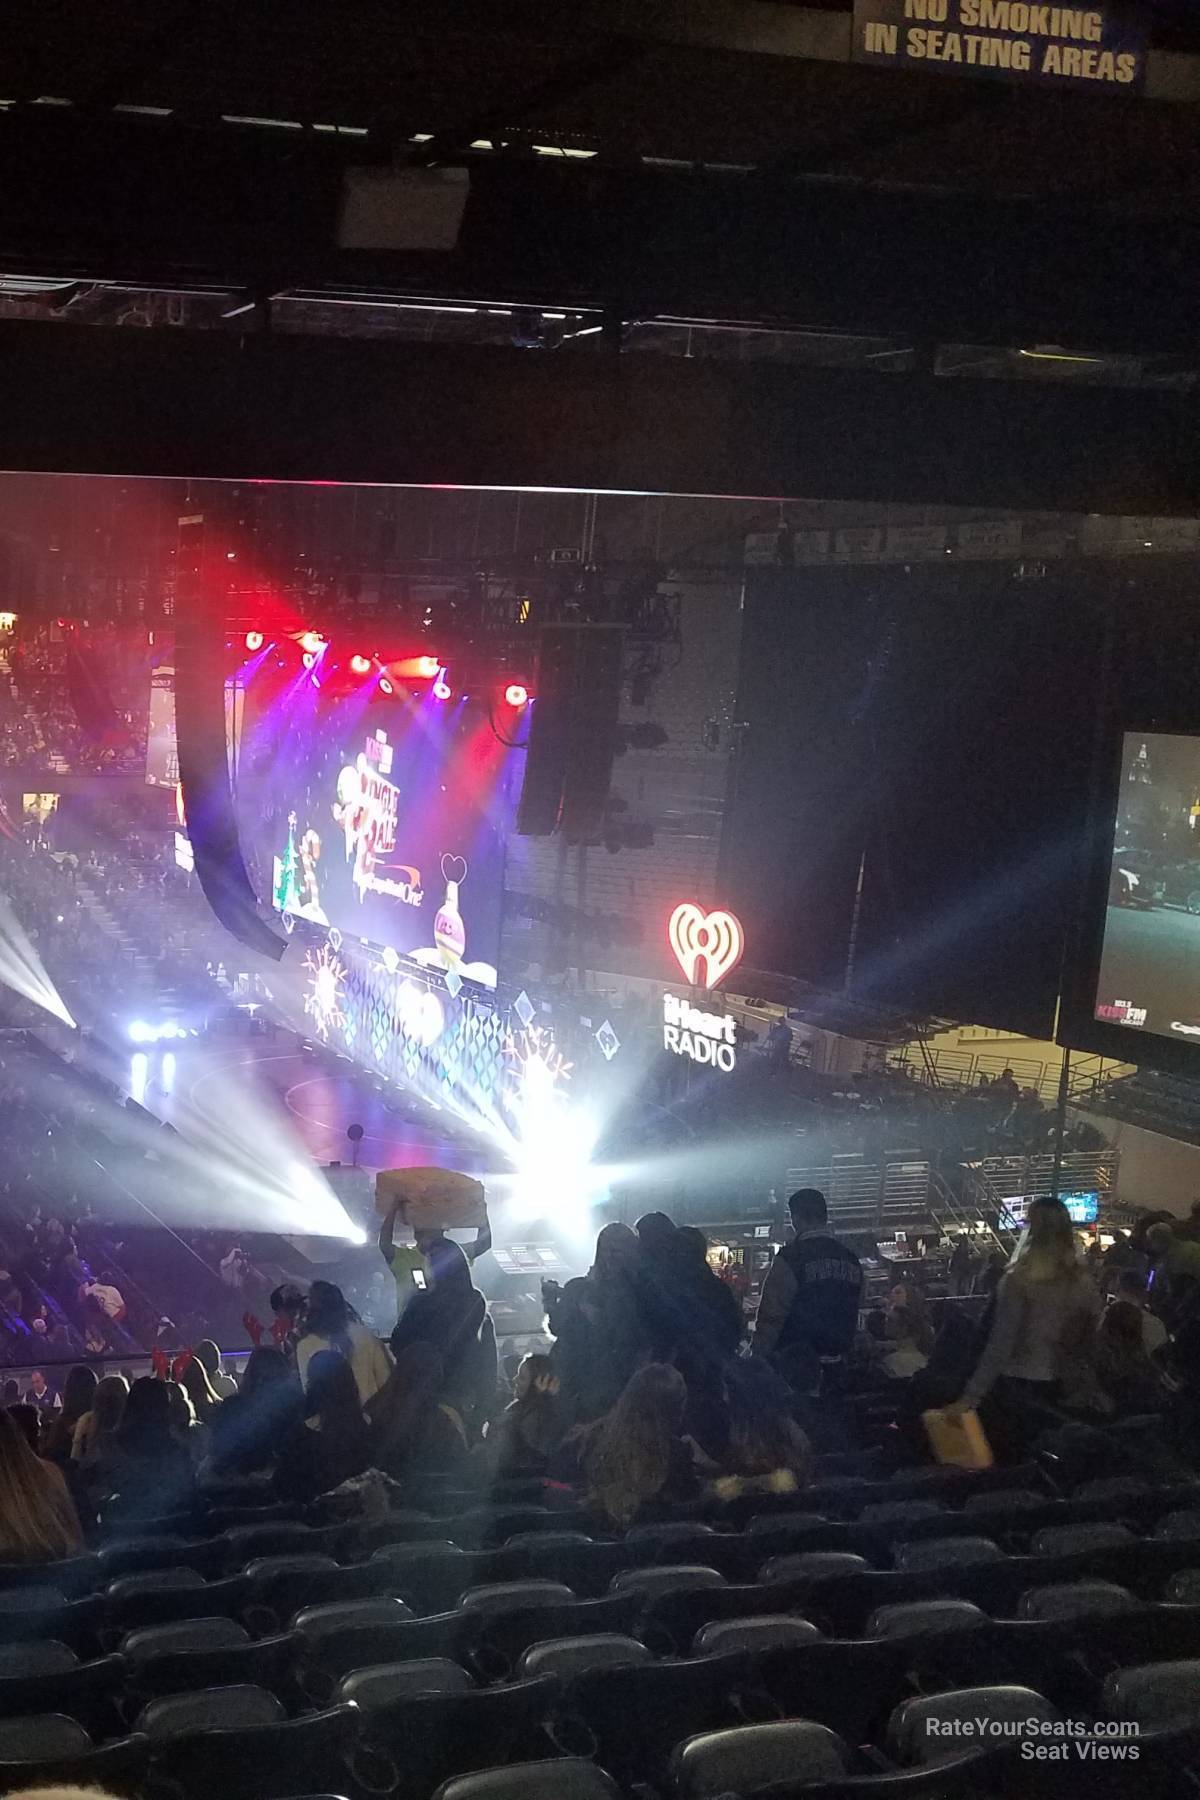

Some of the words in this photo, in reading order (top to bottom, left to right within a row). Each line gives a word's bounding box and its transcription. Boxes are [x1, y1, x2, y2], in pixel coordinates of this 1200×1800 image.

[904, 0, 947, 23] NO
[959, 0, 1102, 42] SMOKING
[864, 22, 898, 54] IN
[907, 27, 1031, 70] SEATING
[1042, 45, 1136, 83] AREAS
[663, 993, 736, 1044] iHeart
[663, 1025, 735, 1072] RADIO
